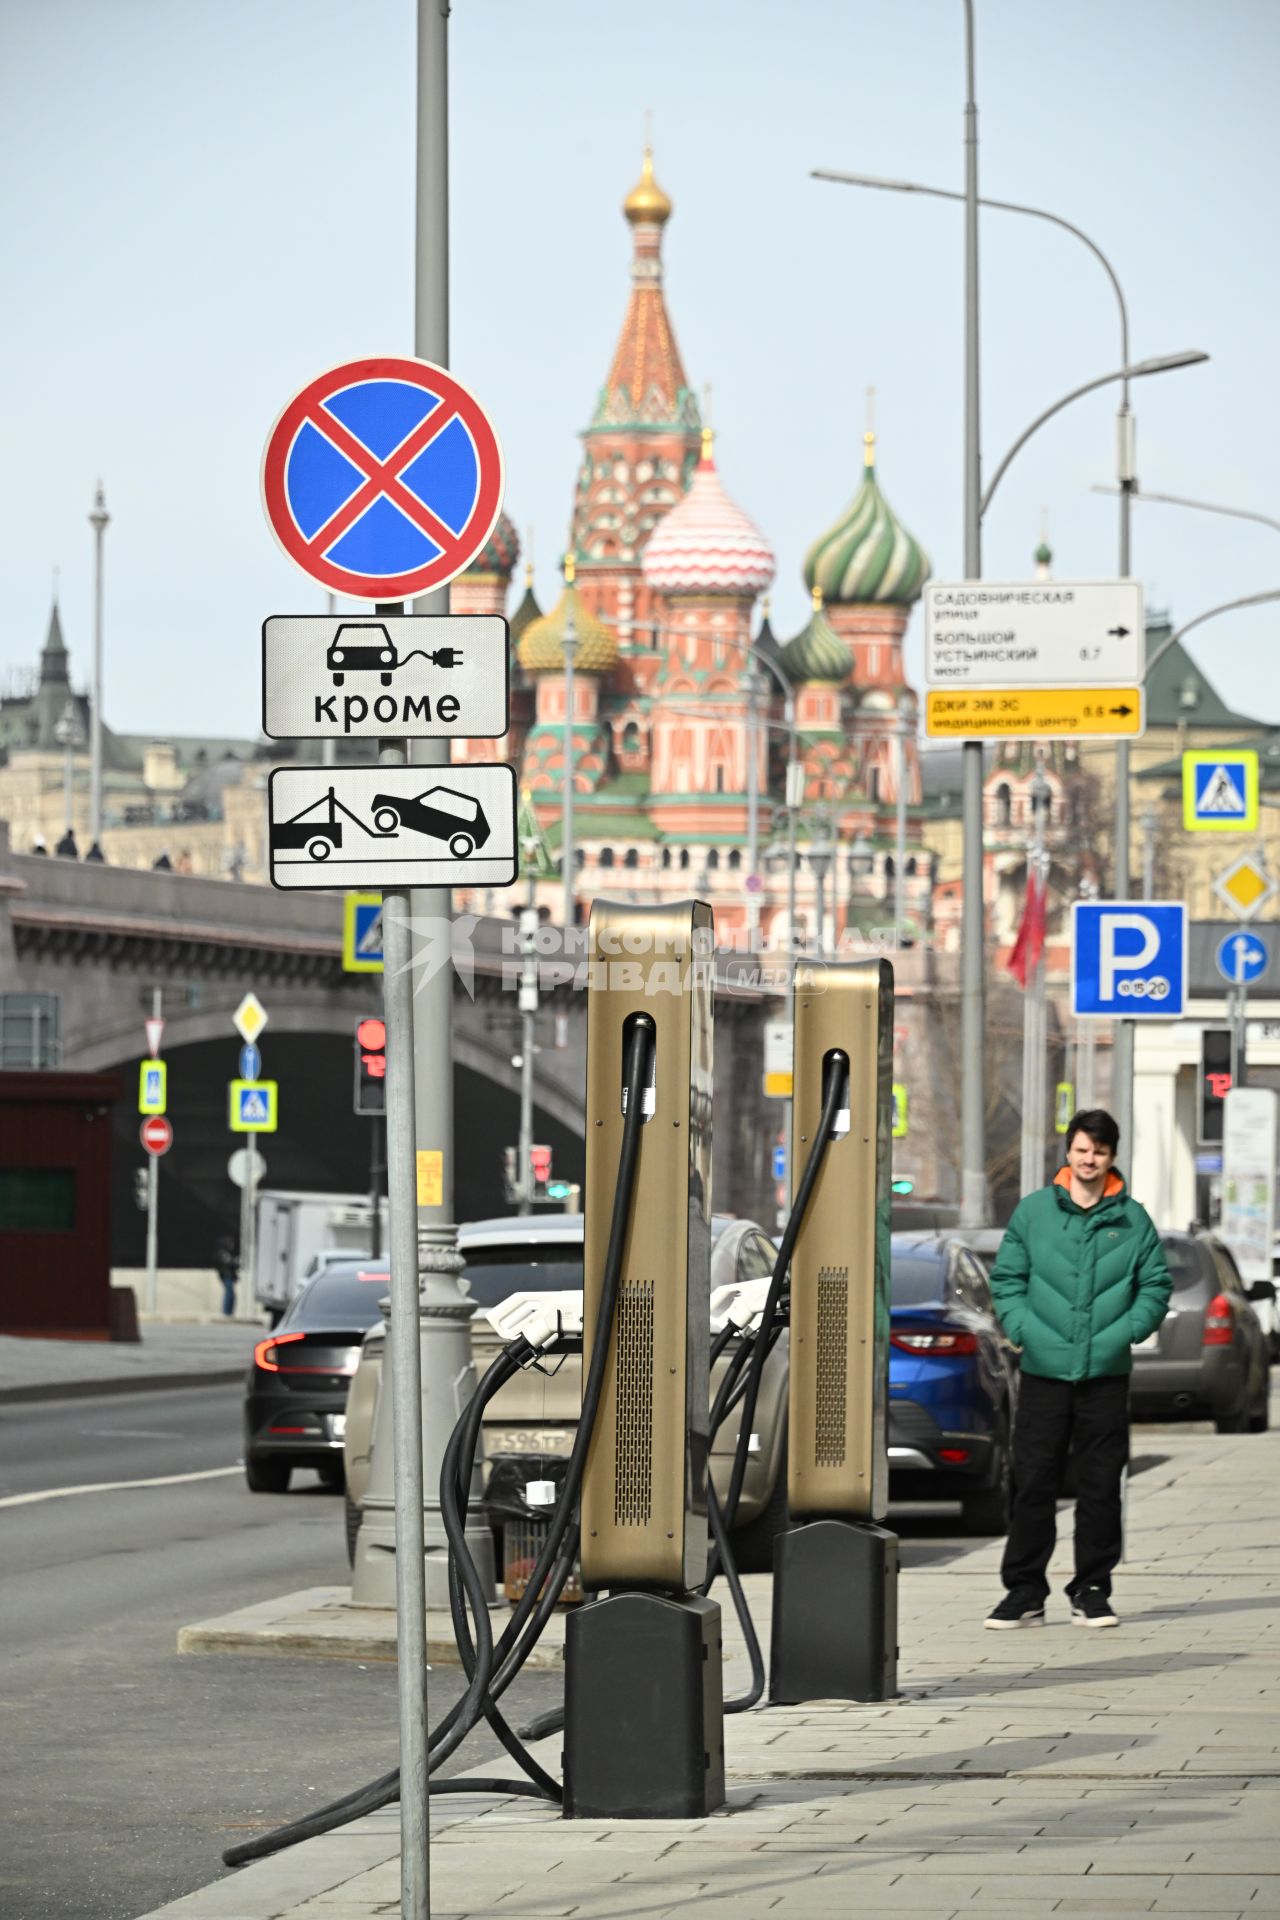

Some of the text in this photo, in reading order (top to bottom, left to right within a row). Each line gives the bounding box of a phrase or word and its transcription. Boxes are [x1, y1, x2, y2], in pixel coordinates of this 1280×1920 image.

[314, 694, 461, 733] кроме
[1099, 913, 1160, 1001] P
[1133, 983, 1145, 994] 15
[1148, 982, 1167, 995] 20
